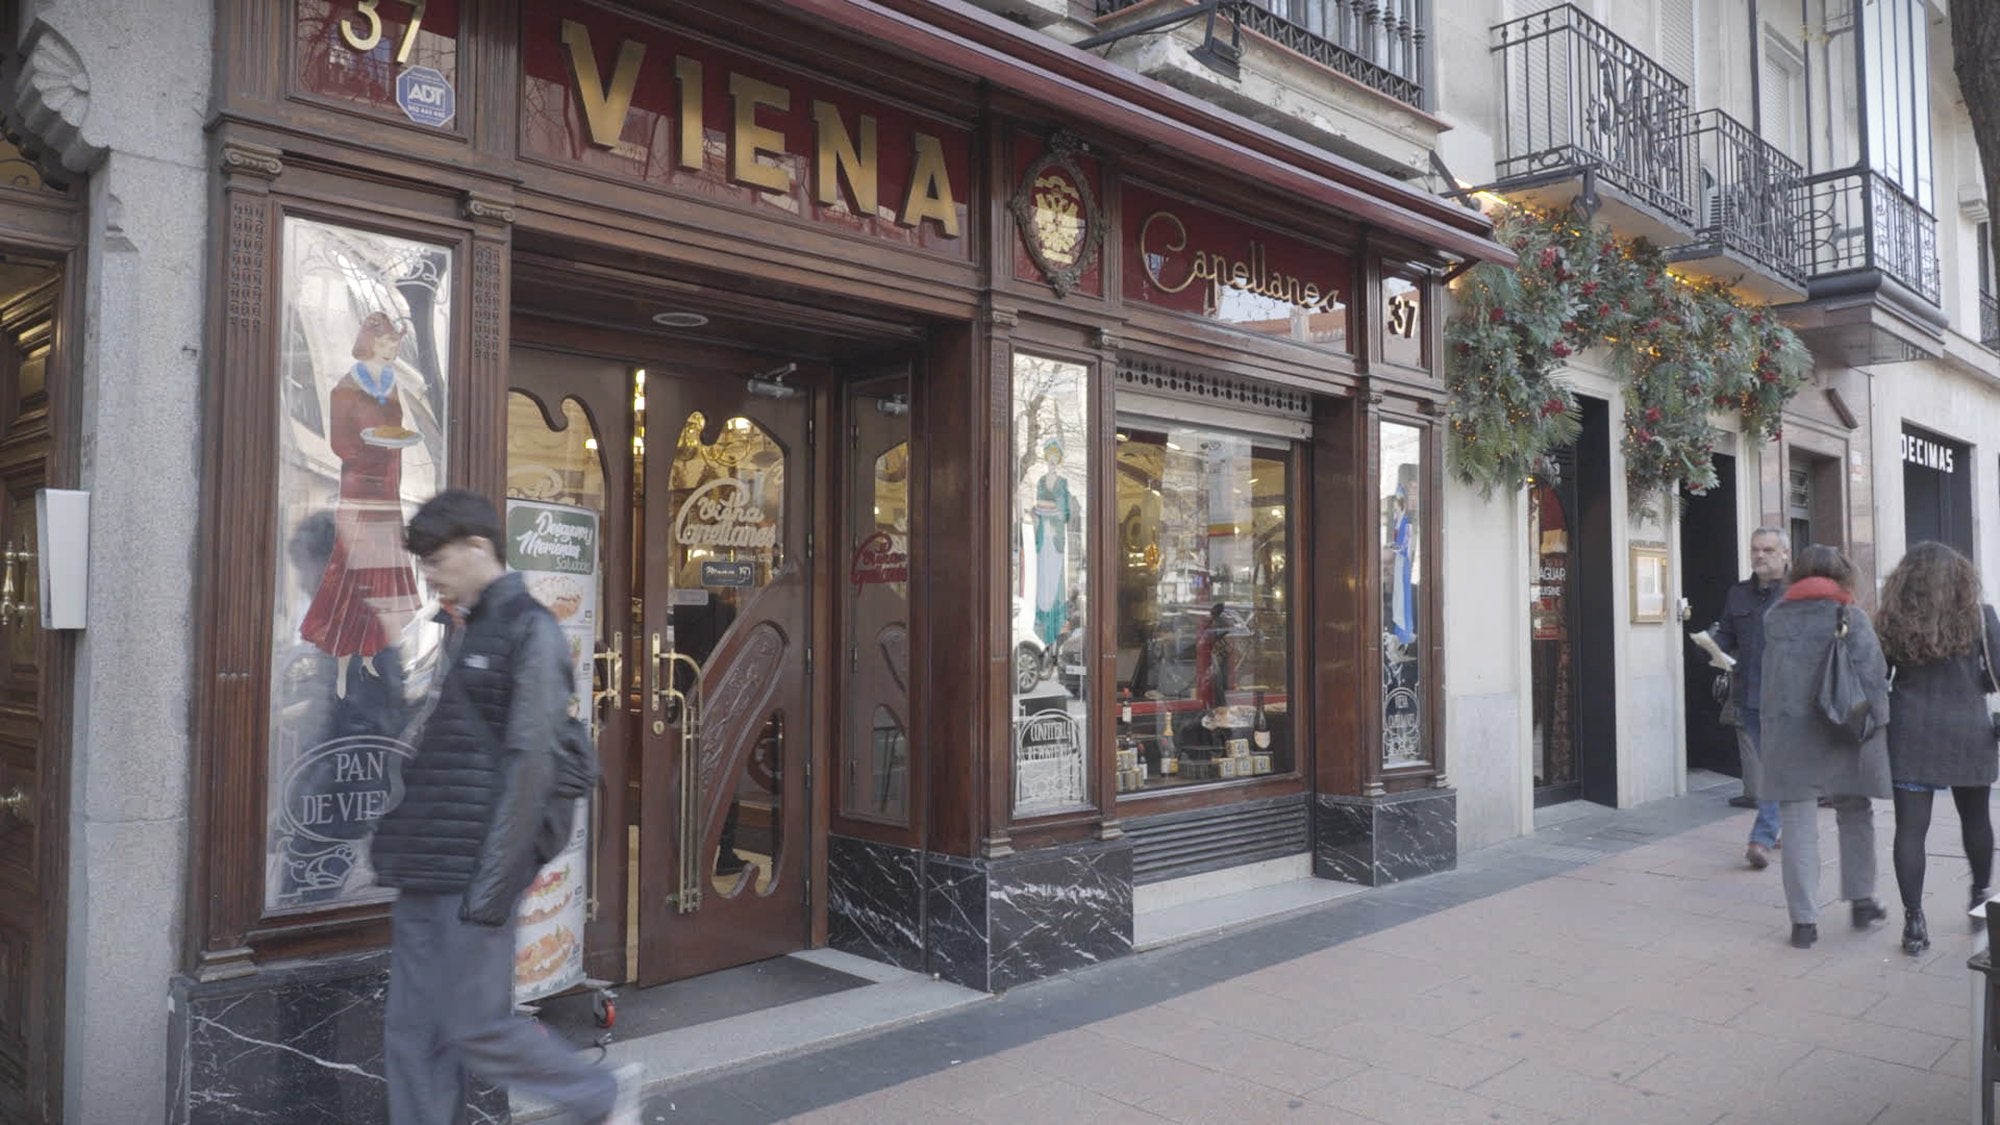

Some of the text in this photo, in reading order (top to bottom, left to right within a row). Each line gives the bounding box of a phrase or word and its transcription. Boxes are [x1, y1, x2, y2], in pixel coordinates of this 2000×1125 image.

[341, 0, 426, 64] 37
[408, 83, 445, 106] ADT
[561, 18, 960, 239] VIENA
[1141, 211, 1340, 316] Capellanes
[1388, 294, 1420, 339] 37
[1901, 433, 1953, 473] DECIMAS
[335, 751, 385, 782] PAN
[302, 790, 391, 826] DE VIEN
